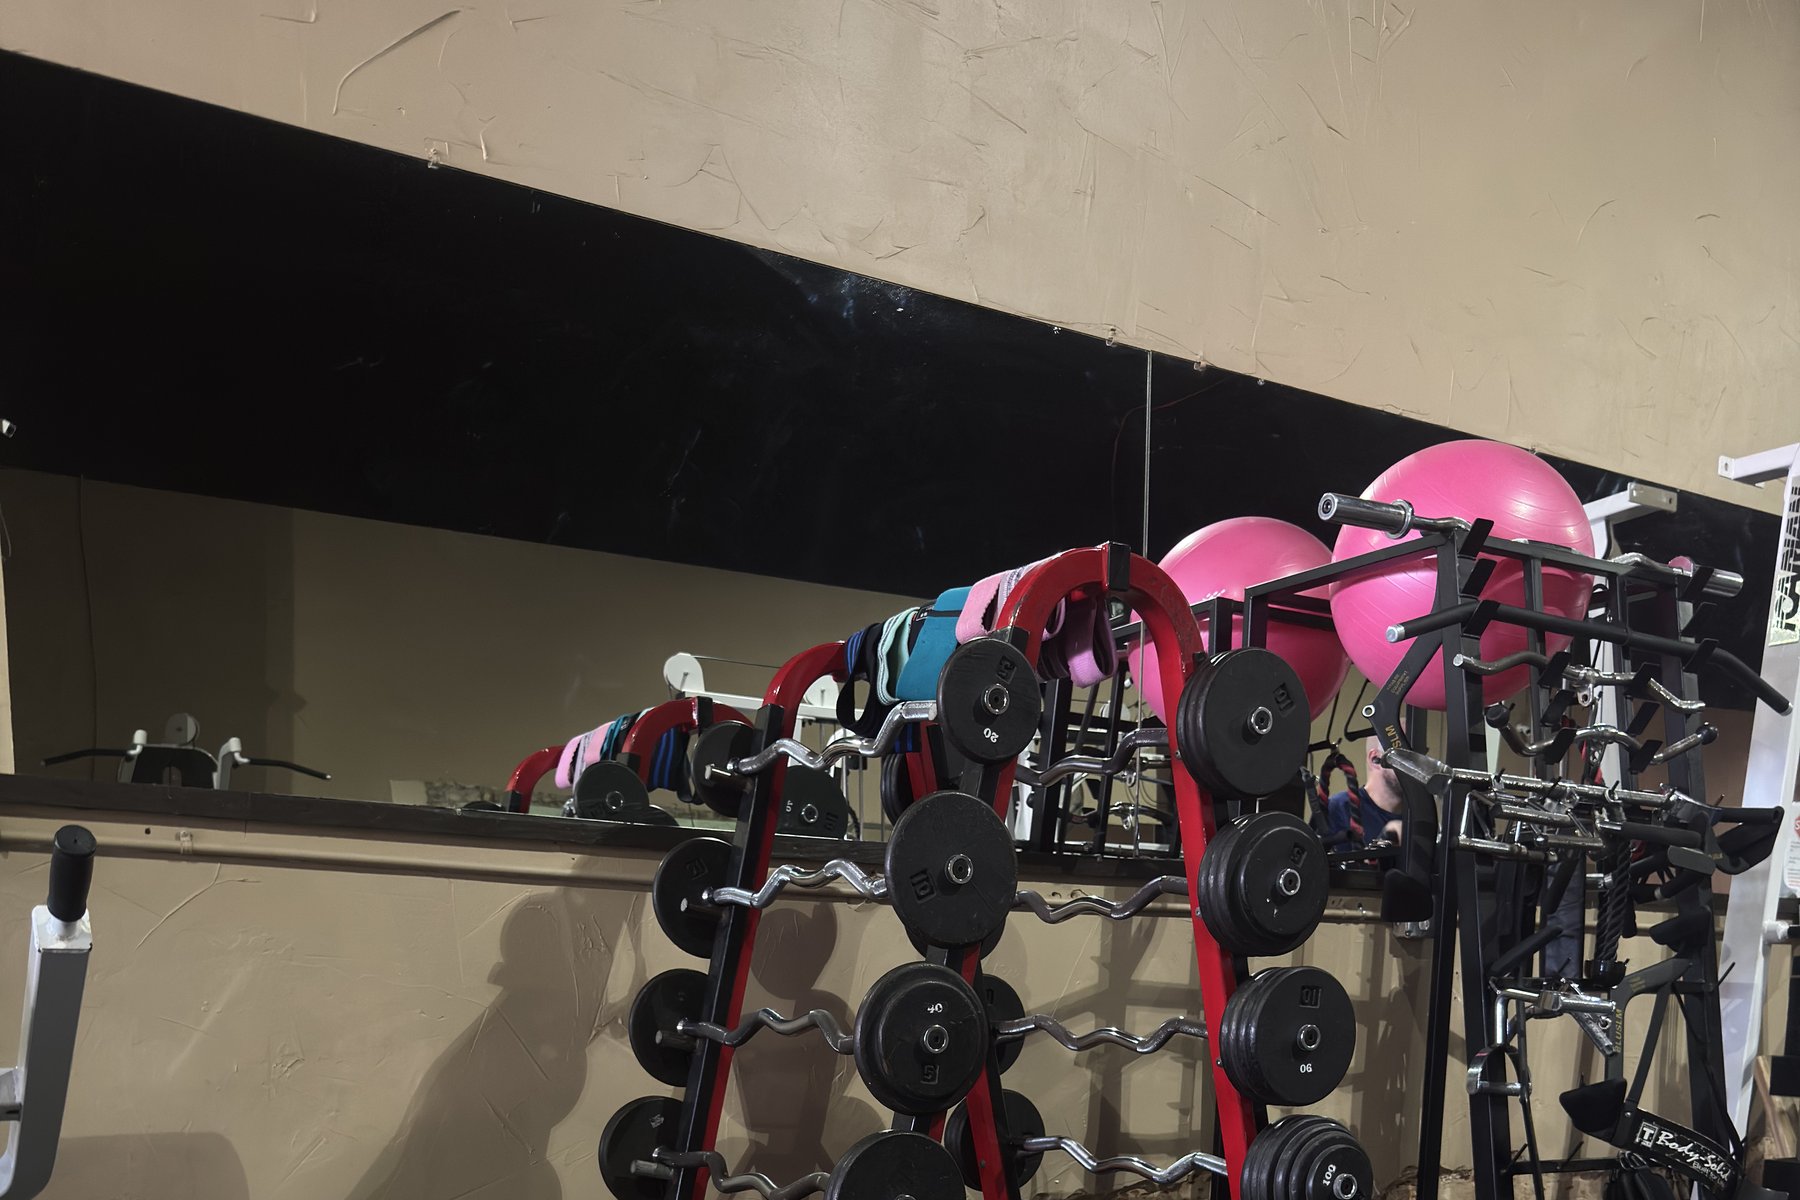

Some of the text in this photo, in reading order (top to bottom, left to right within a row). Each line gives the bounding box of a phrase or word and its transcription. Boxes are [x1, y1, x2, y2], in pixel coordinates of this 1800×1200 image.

[983, 727, 999, 743] 20
[1384, 724, 1402, 749] SLM
[927, 1003, 943, 1014] 40
[1655, 1130, 1732, 1182] Body-Solid
[1322, 1164, 1336, 1187] 100
